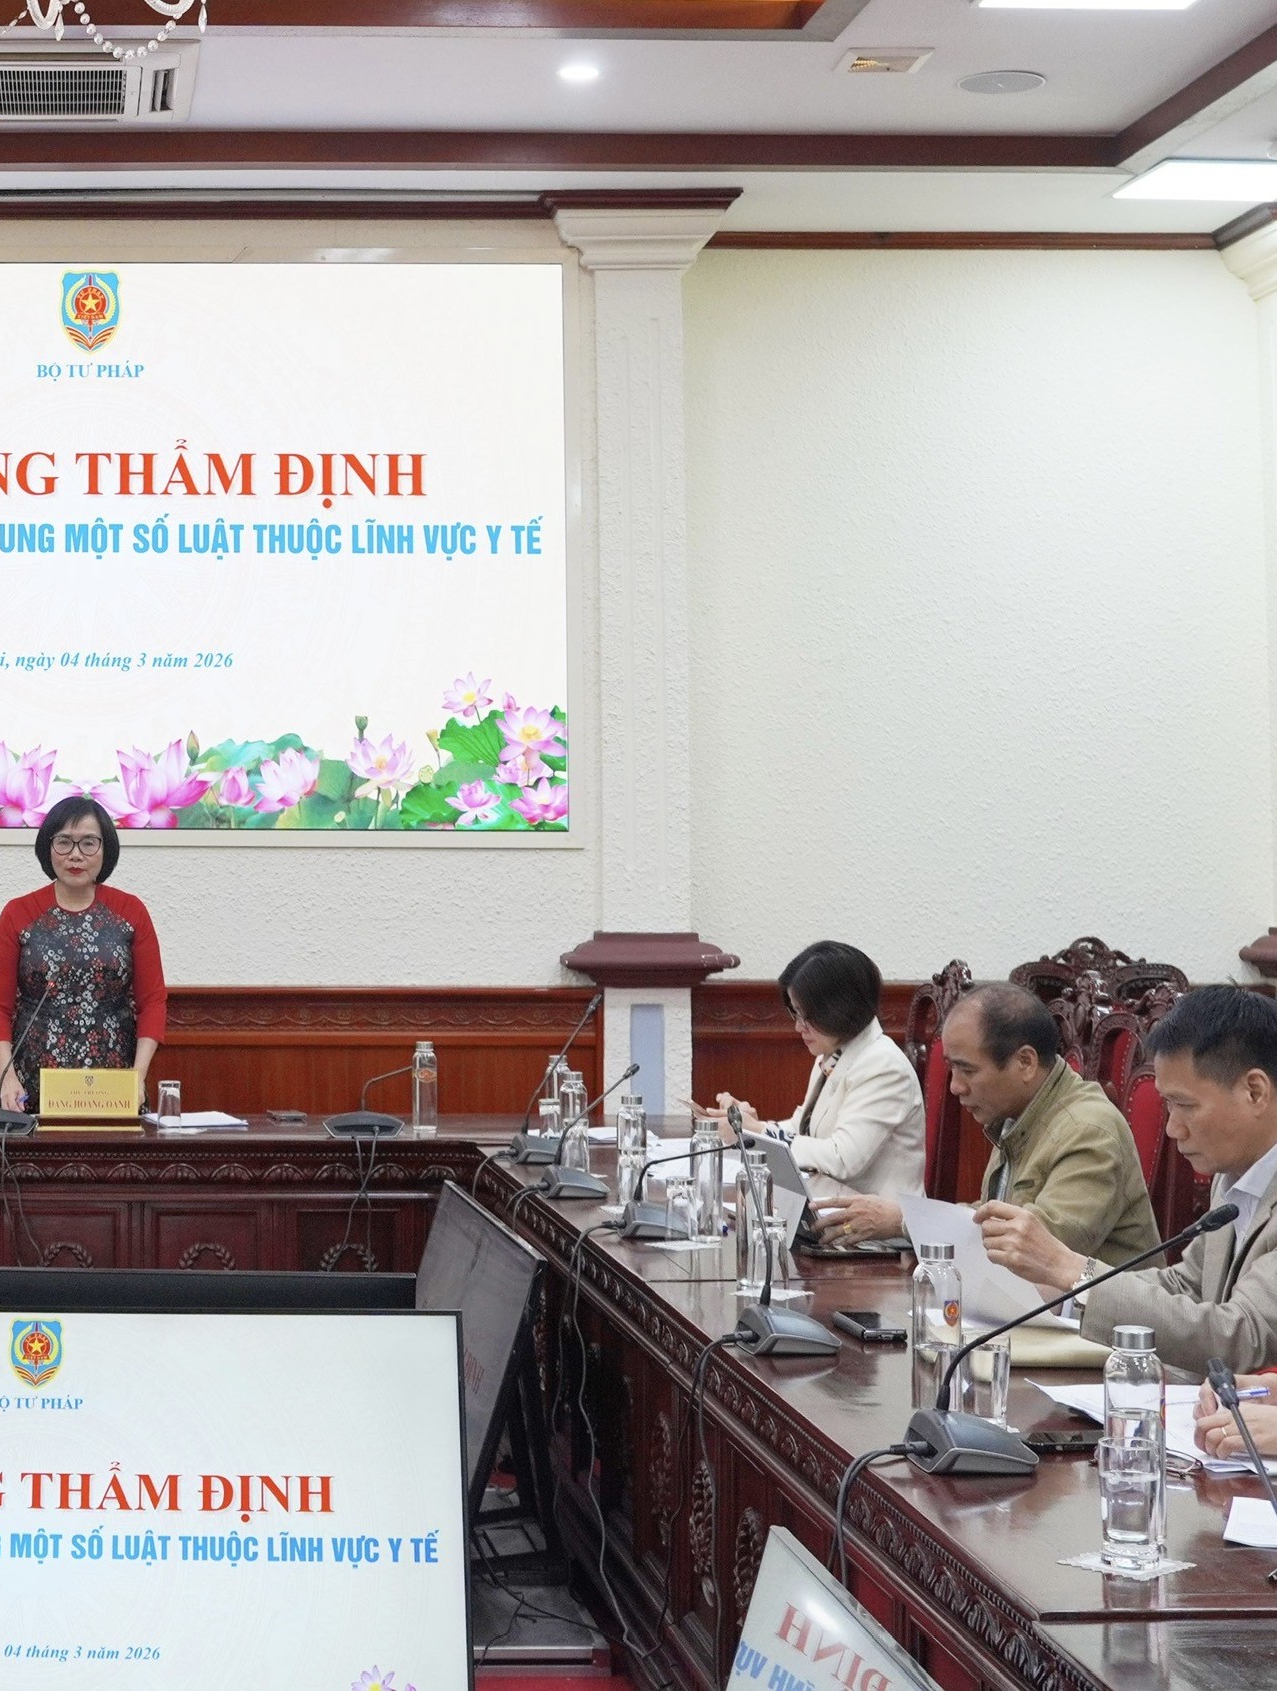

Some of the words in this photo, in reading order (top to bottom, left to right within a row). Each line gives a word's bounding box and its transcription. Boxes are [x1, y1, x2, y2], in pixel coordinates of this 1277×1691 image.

[37, 362, 61, 381] BỘ
[66, 362, 93, 378] TƯ
[97, 360, 144, 378] PHÁP
[76, 438, 256, 496] THẨM
[274, 454, 426, 509] ĐỊNH
[65, 517, 123, 559] MỘT
[133, 514, 169, 553] SỐ
[179, 518, 244, 560] LUẬT
[253, 518, 341, 560] THUỘC
[352, 518, 413, 554] LĨNH
[423, 522, 476, 560] VỰC
[486, 526, 501, 554] Y
[511, 516, 542, 554] TẾ
[15, 652, 55, 671] ngày
[60, 652, 80, 667] 04
[84, 652, 132, 671] tháng
[137, 653, 147, 667] 3
[151, 653, 188, 668] năm
[193, 653, 233, 668] 2026
[14, 1396, 38, 1409] TƯ
[41, 1395, 84, 1409] PHÁP
[21, 1461, 181, 1512] THẨM
[198, 1475, 334, 1523] ĐỊNH
[11, 1528, 62, 1564] MỘT
[71, 1526, 103, 1559] SỐ
[112, 1530, 170, 1565] LUẬT
[179, 1531, 258, 1567] THUỘC
[268, 1532, 323, 1562] LĨNH
[332, 1536, 379, 1568] VỰC
[388, 1538, 402, 1562] Y
[410, 1530, 439, 1564] TẾ
[4, 1645, 22, 1657] 04
[26, 1646, 68, 1662] tháng
[73, 1647, 83, 1659] 3
[87, 1648, 120, 1660] năm
[125, 1647, 160, 1660] 2026
